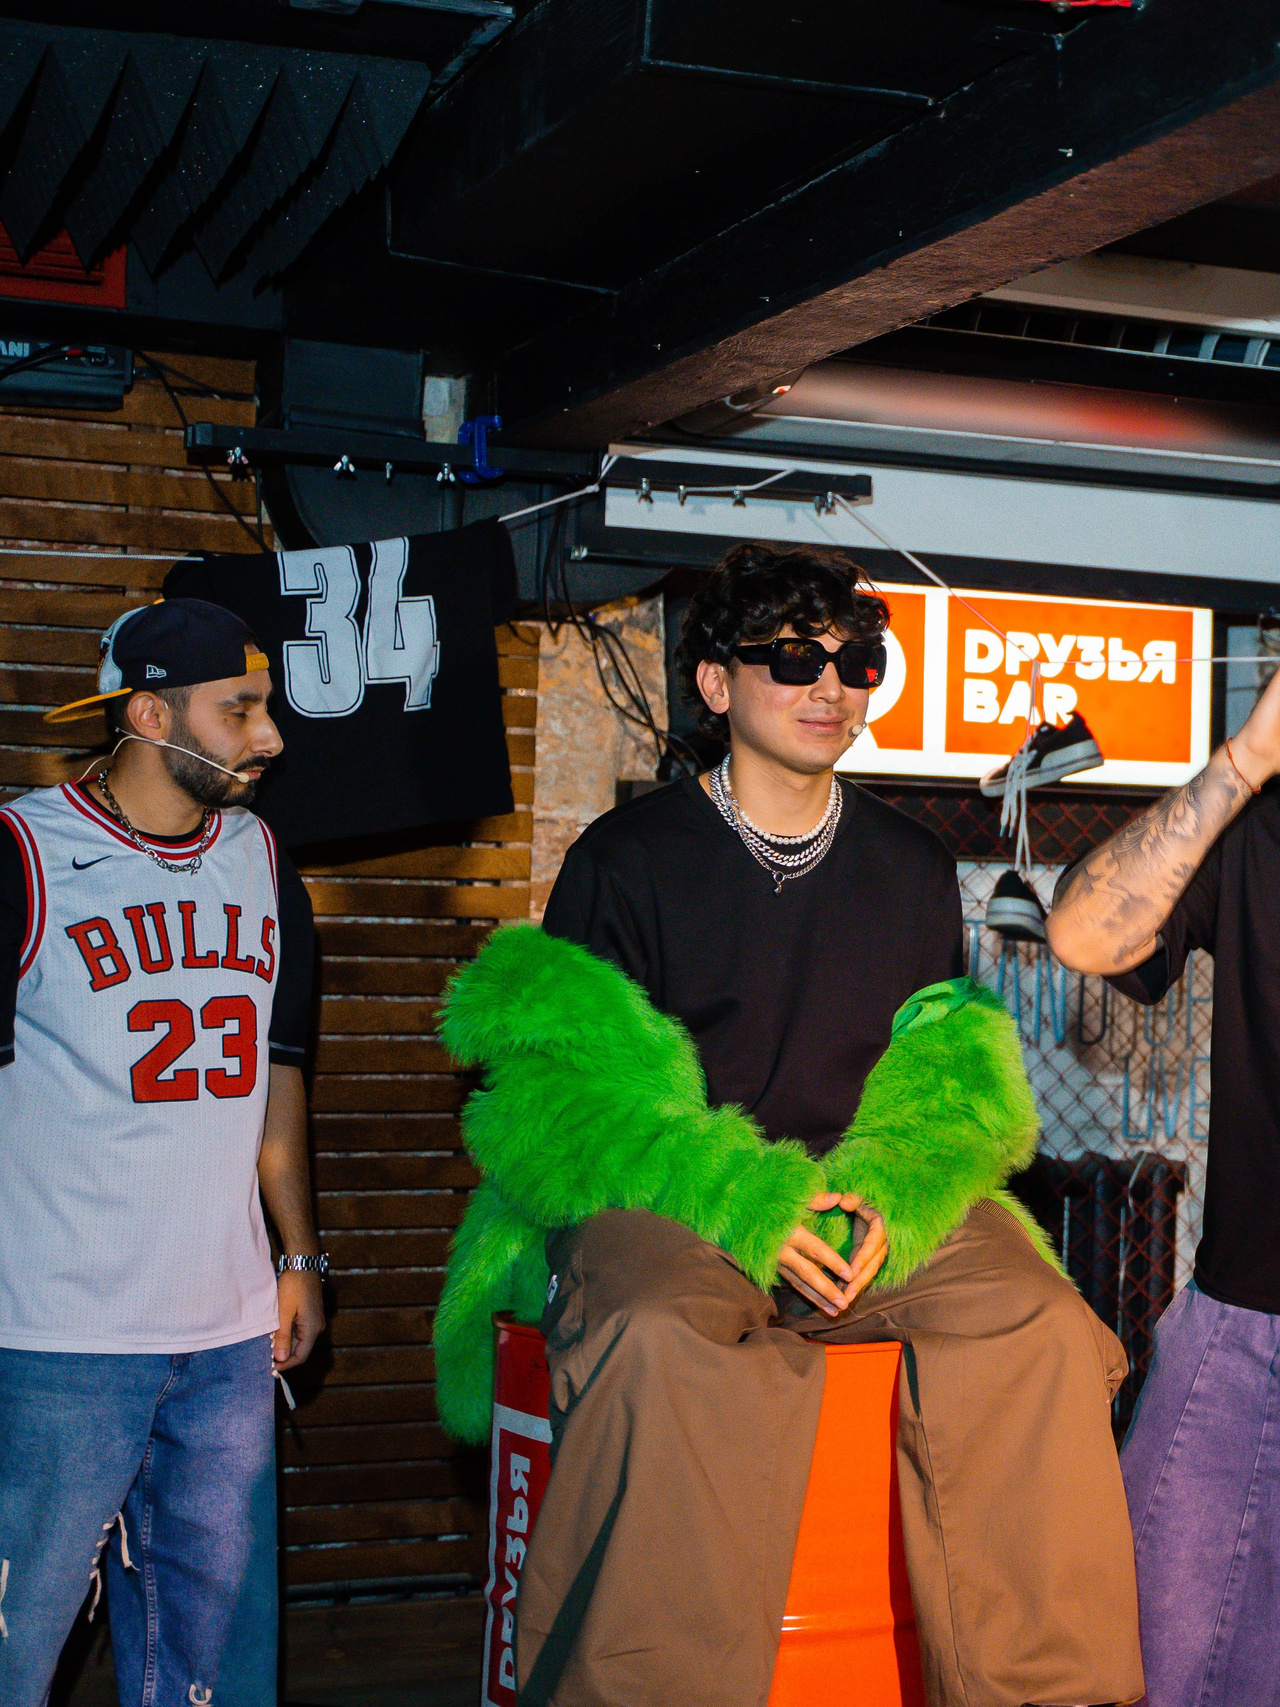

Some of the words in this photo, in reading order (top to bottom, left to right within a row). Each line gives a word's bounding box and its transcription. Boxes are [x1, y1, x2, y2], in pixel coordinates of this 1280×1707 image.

[277, 536, 440, 718] 34
[963, 678, 1078, 726] BAR
[64, 900, 276, 993] BULLS
[127, 995, 258, 1103] 23
